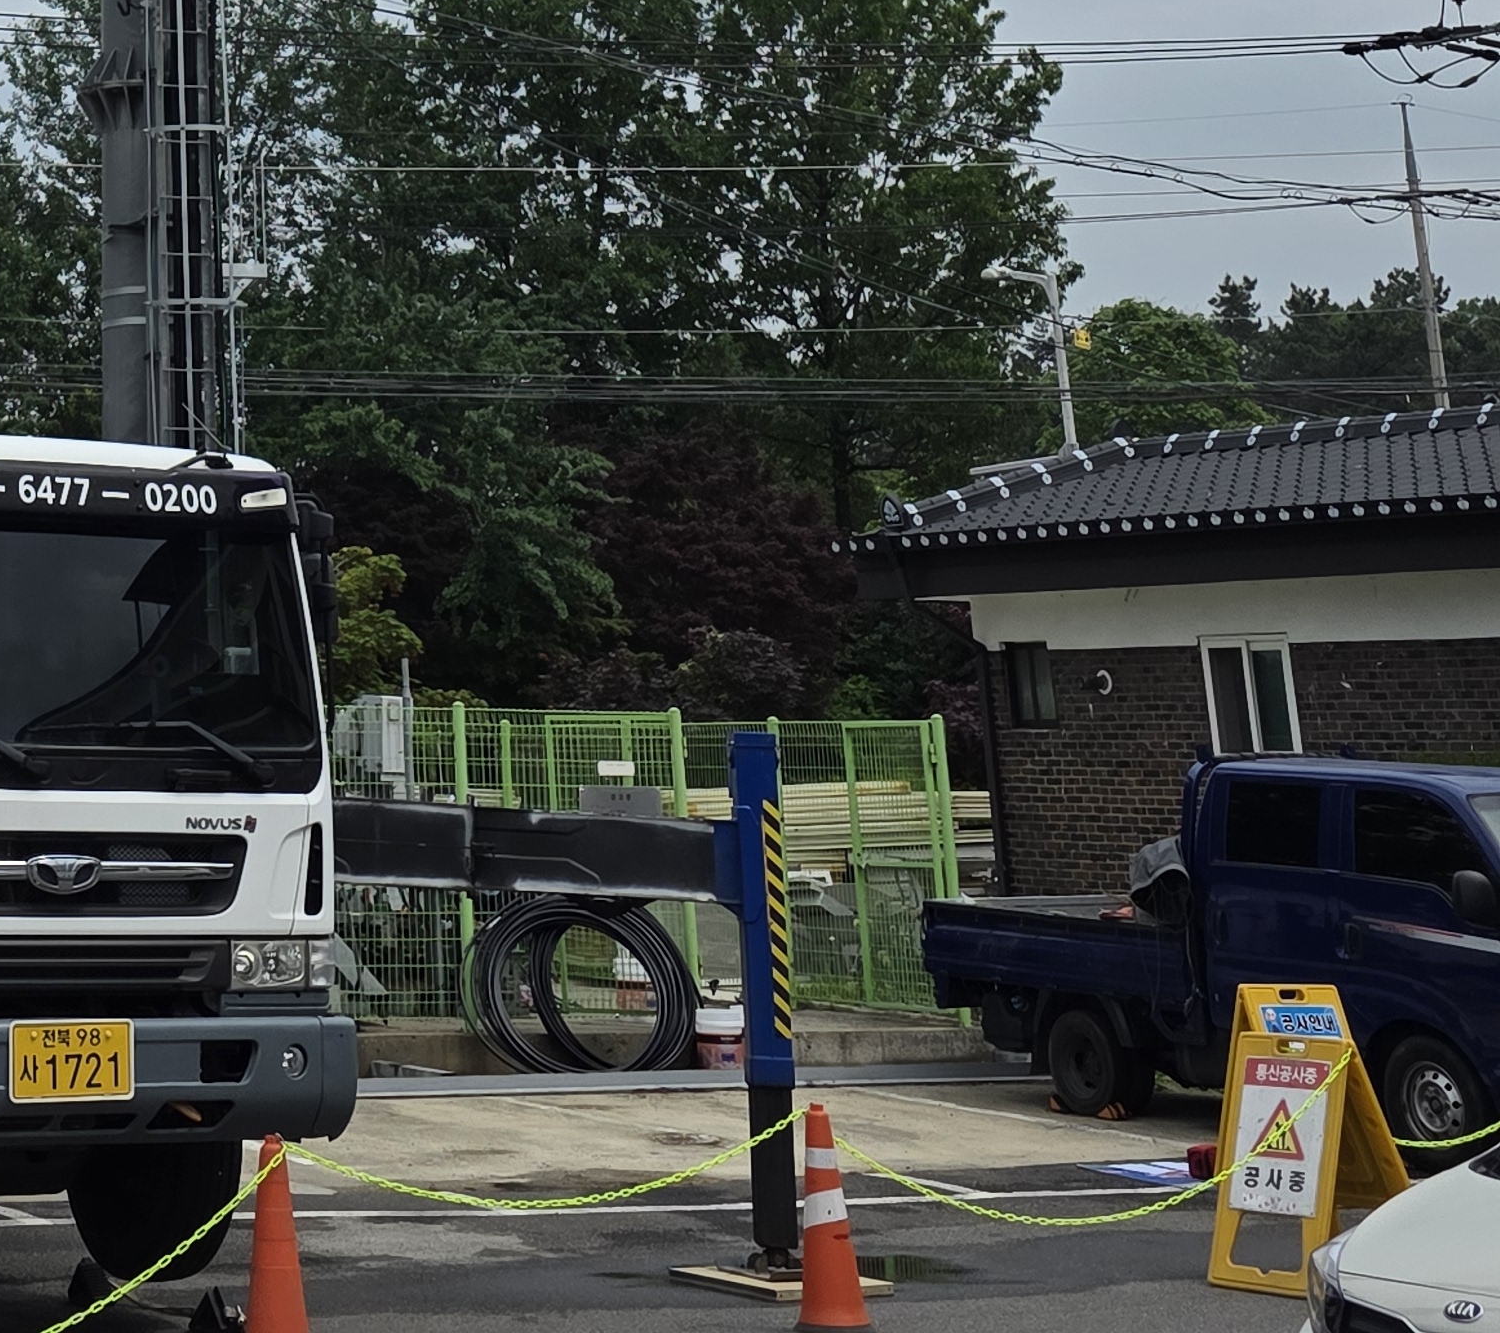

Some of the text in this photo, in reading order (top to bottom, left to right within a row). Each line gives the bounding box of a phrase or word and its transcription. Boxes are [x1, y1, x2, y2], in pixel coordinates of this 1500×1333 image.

[18, 474, 90, 506] 6477
[145, 482, 218, 515] 0200
[185, 816, 242, 831] NOVUS
[1280, 1014, 1337, 1032] 공사안내
[42, 1028, 101, 1048] 전북 98
[1255, 1064, 1318, 1085] 통신공사중
[1447, 1302, 1475, 1318] KIA
